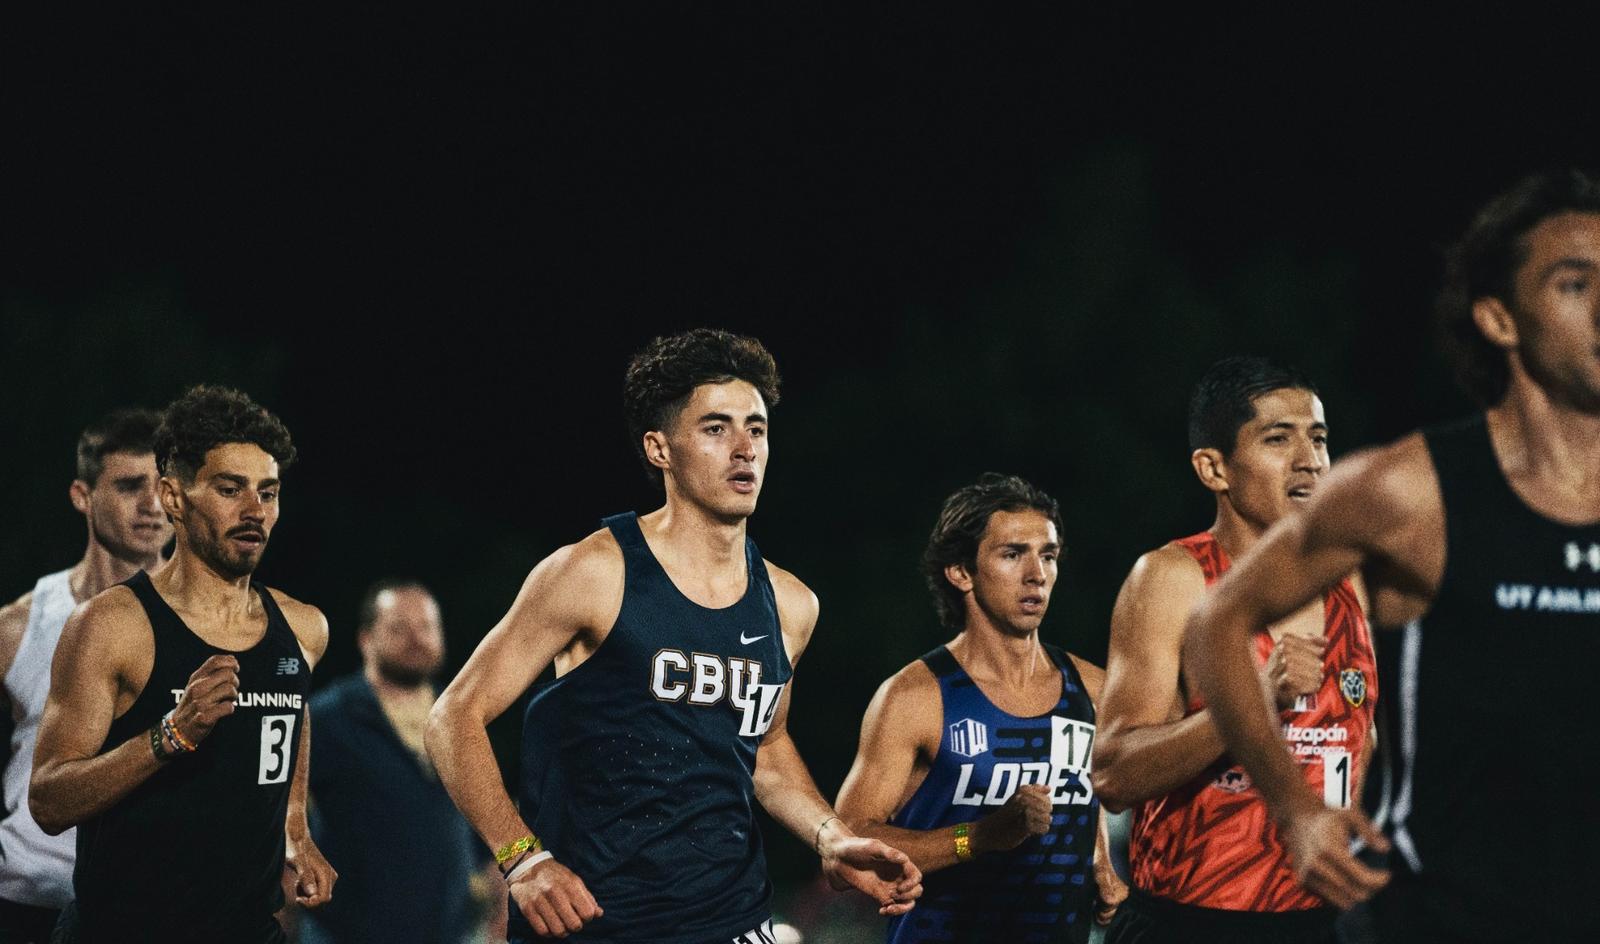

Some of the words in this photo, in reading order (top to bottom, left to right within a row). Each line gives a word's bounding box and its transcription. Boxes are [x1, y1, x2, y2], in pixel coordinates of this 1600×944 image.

[1495, 583, 1533, 609] UT
[650, 648, 763, 711] CBU
[265, 719, 287, 781] 3
[1061, 723, 1095, 769] 17
[1336, 756, 1348, 807] 1
